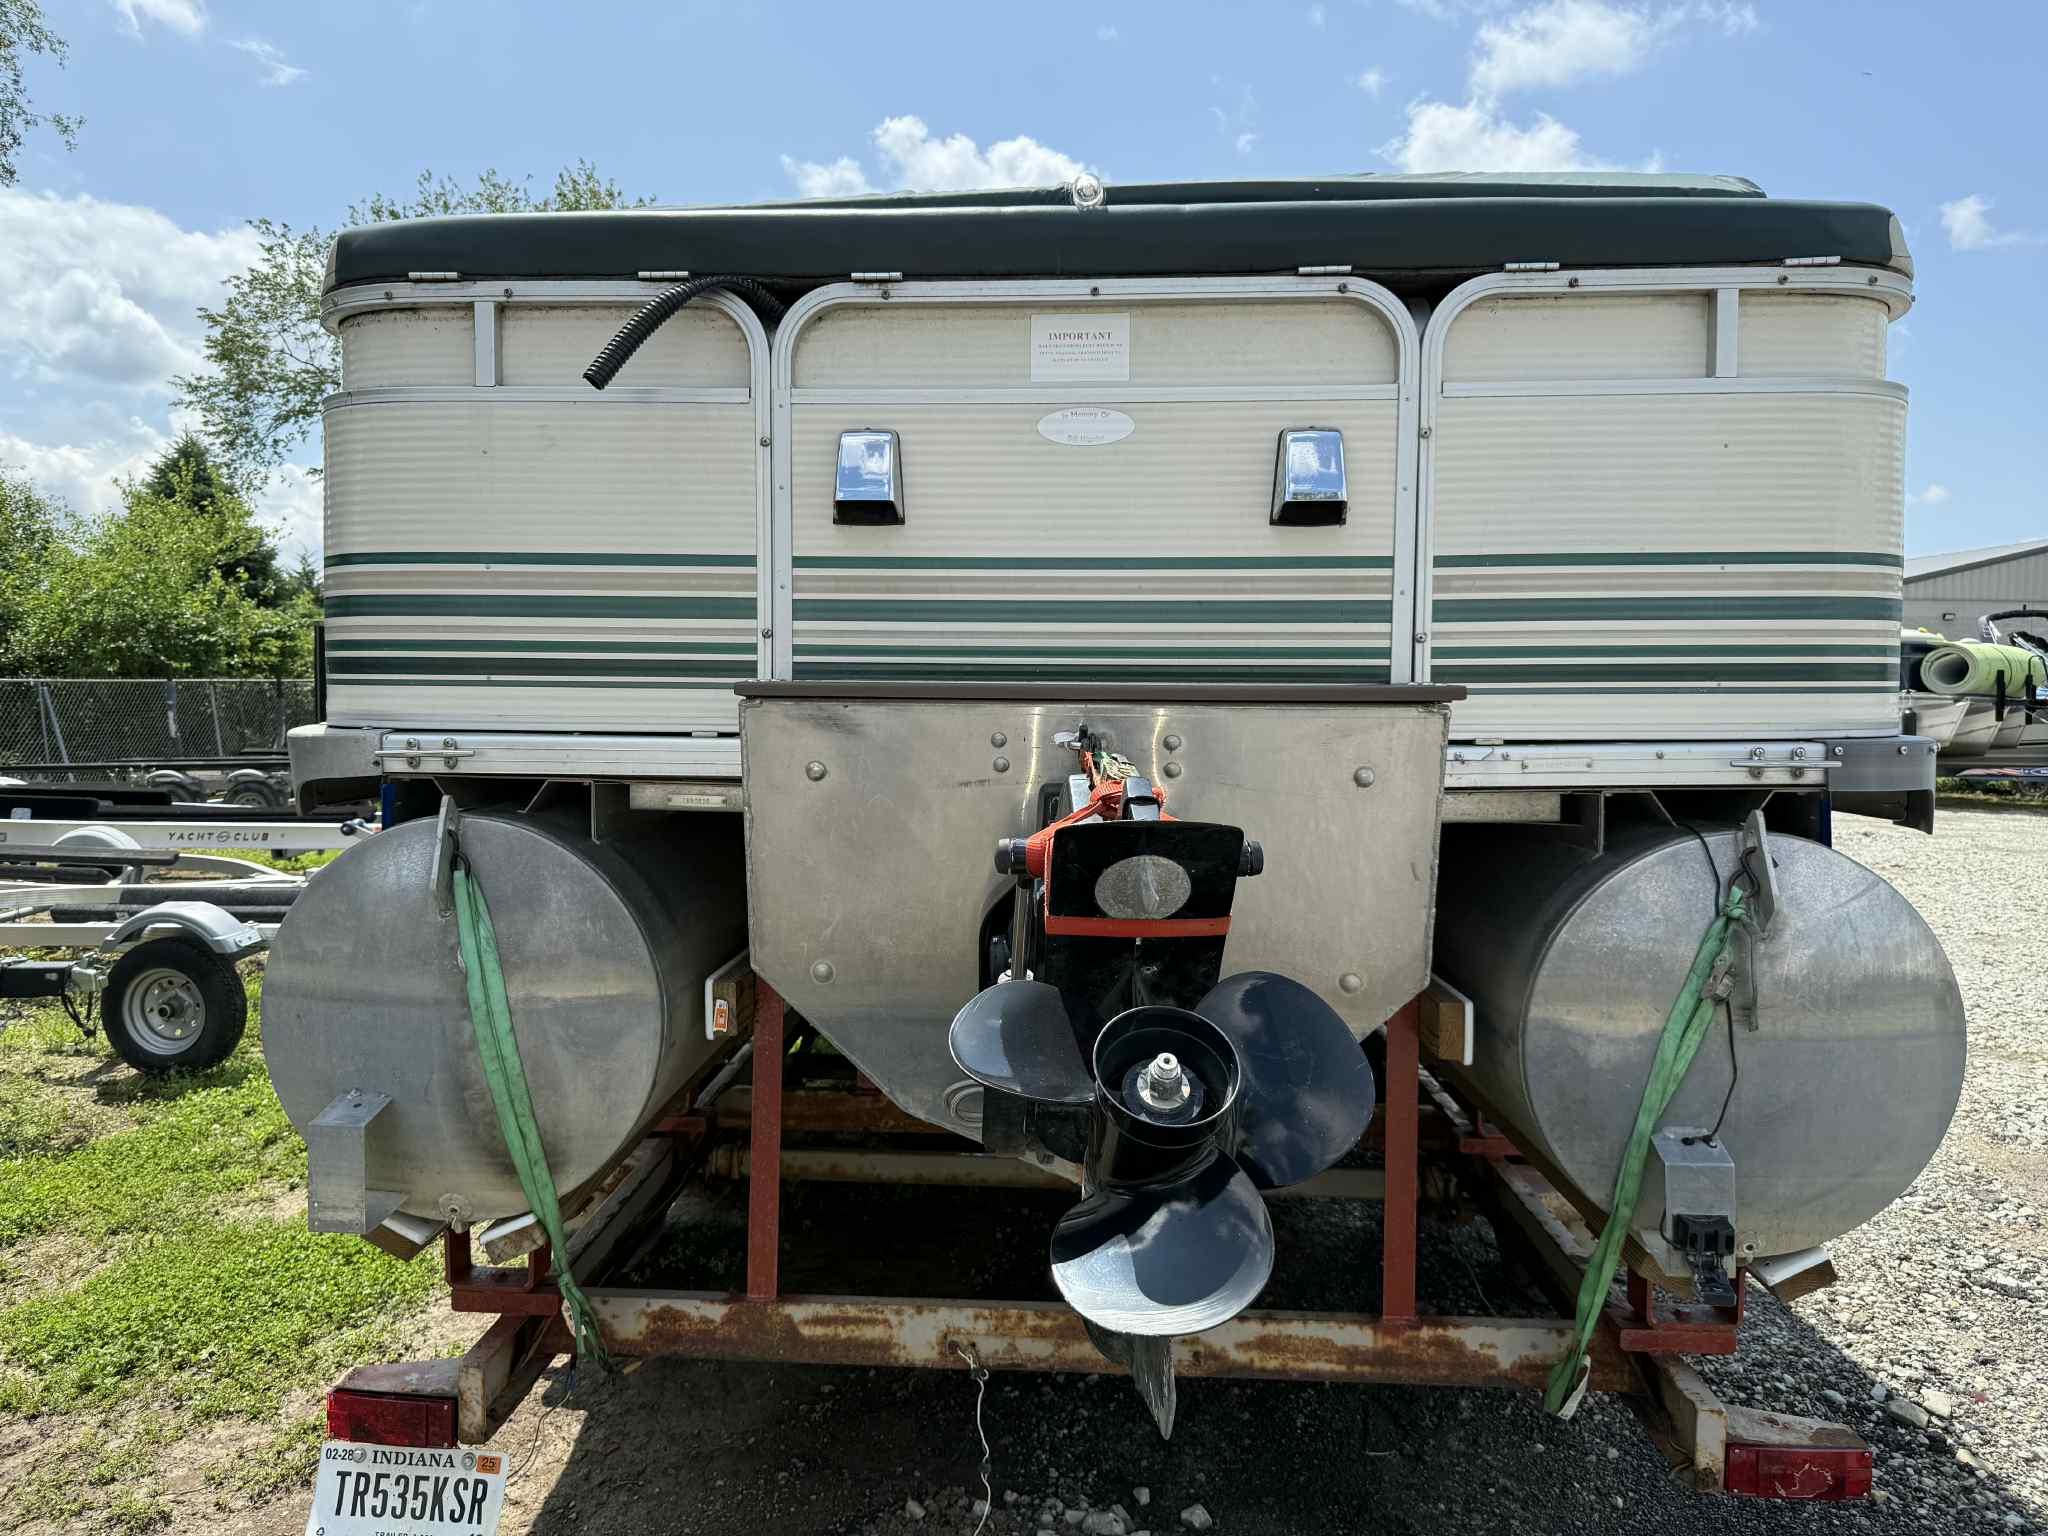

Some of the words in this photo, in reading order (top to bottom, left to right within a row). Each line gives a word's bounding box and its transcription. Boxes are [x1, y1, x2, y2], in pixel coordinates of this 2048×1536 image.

[1048, 331, 1112, 341] IMPORTANT
[1070, 411, 1098, 419] Memory
[168, 832, 214, 841] YACHT
[233, 832, 270, 841] CLUB
[325, 1448, 353, 1461] 02-28
[371, 1450, 456, 1468] INDIANA
[482, 1456, 496, 1466] 25
[335, 1470, 489, 1525] TR535KSR
